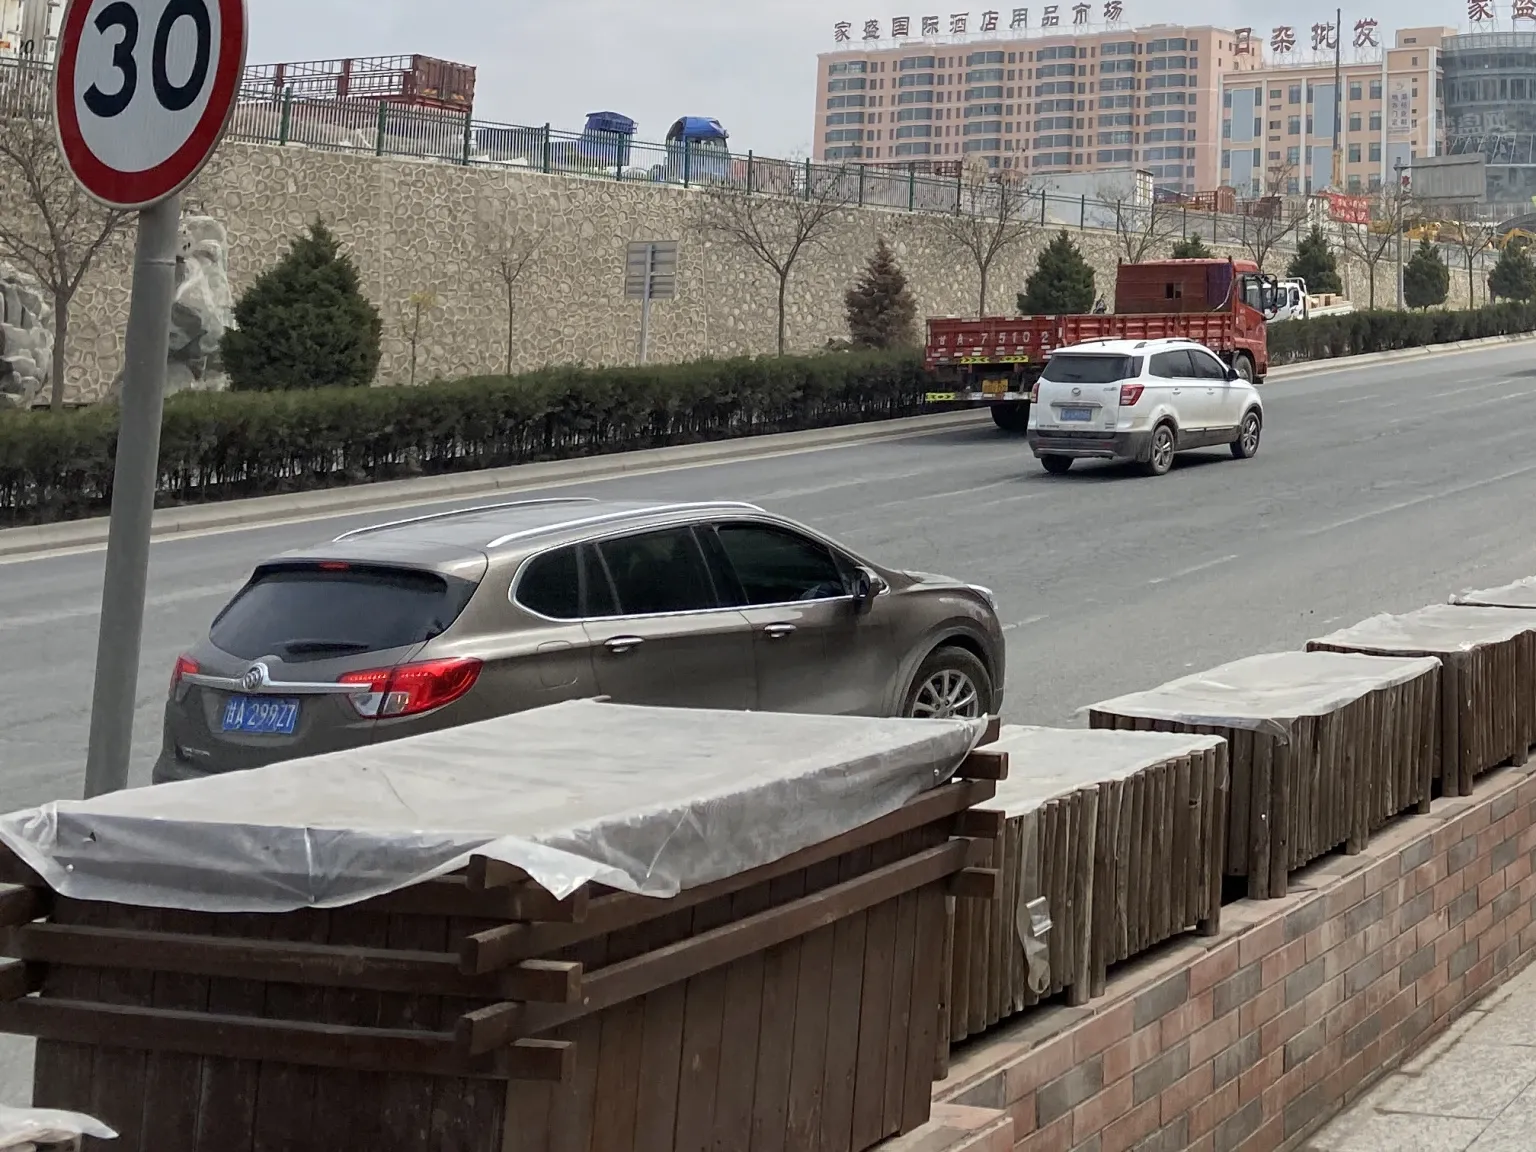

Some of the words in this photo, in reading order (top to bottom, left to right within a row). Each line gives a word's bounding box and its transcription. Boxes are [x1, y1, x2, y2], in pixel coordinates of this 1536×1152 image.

[833, 0, 1123, 43] 家盛国际酒店用品市场
[1234, 17, 1379, 56] 日杂批发
